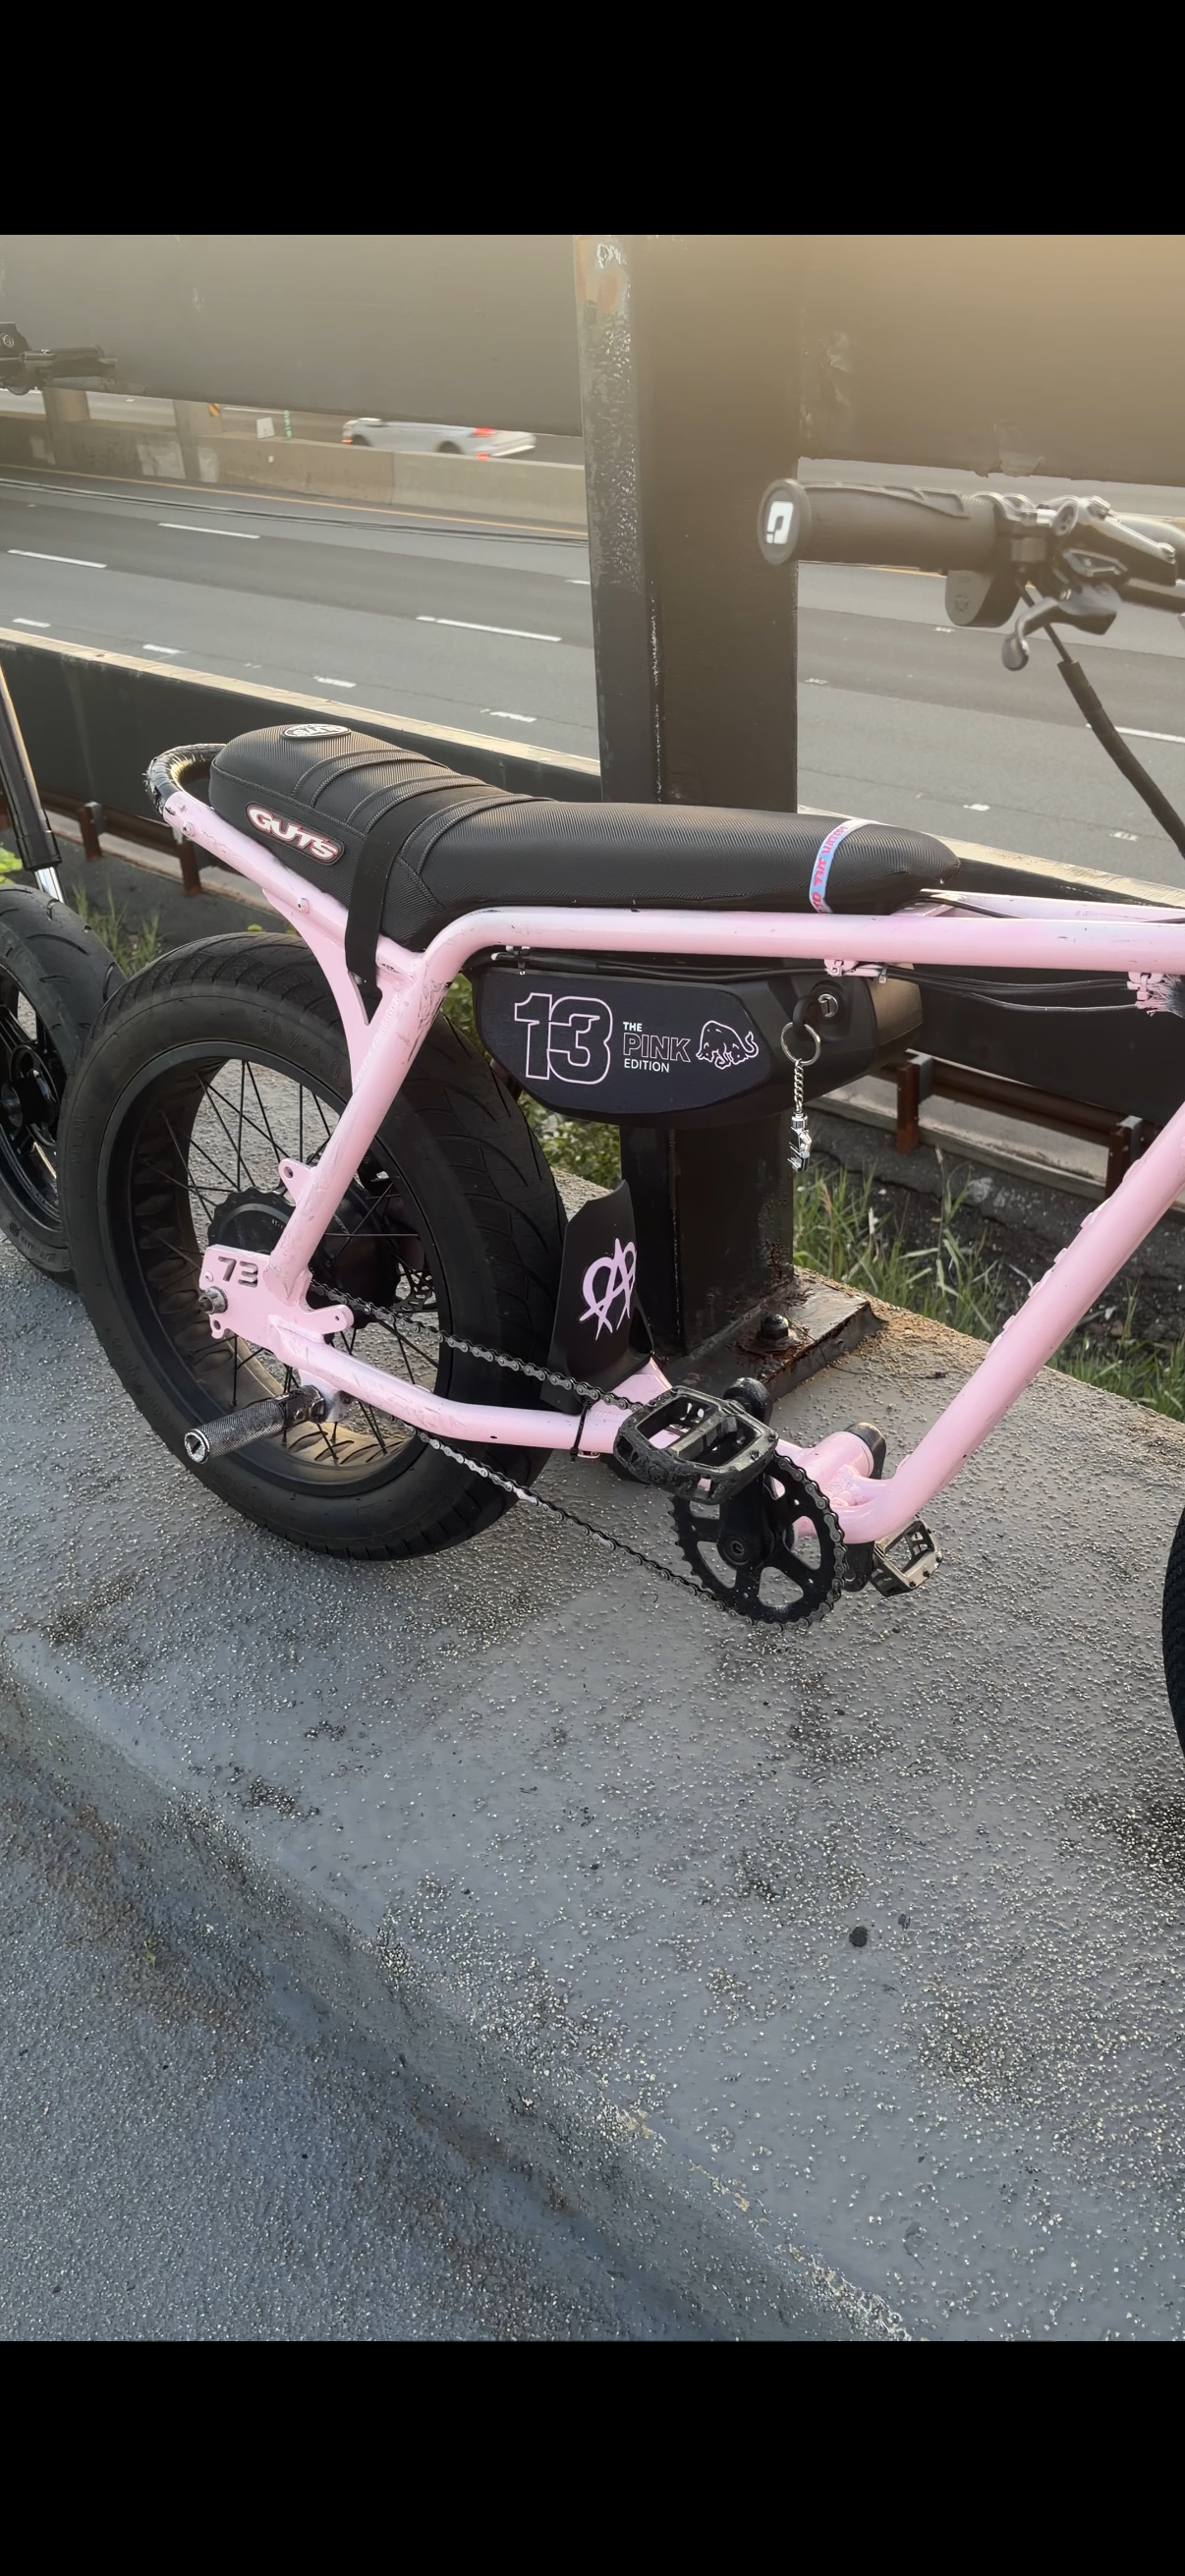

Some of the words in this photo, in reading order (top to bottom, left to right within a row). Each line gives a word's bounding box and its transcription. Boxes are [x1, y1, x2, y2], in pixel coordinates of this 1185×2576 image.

[248, 806, 340, 861] GUTS
[514, 992, 613, 1085] 13
[623, 1022, 643, 1033] THE
[623, 1033, 691, 1063] PINK
[624, 1058, 670, 1073] EDITION
[217, 1256, 259, 1288] 73
